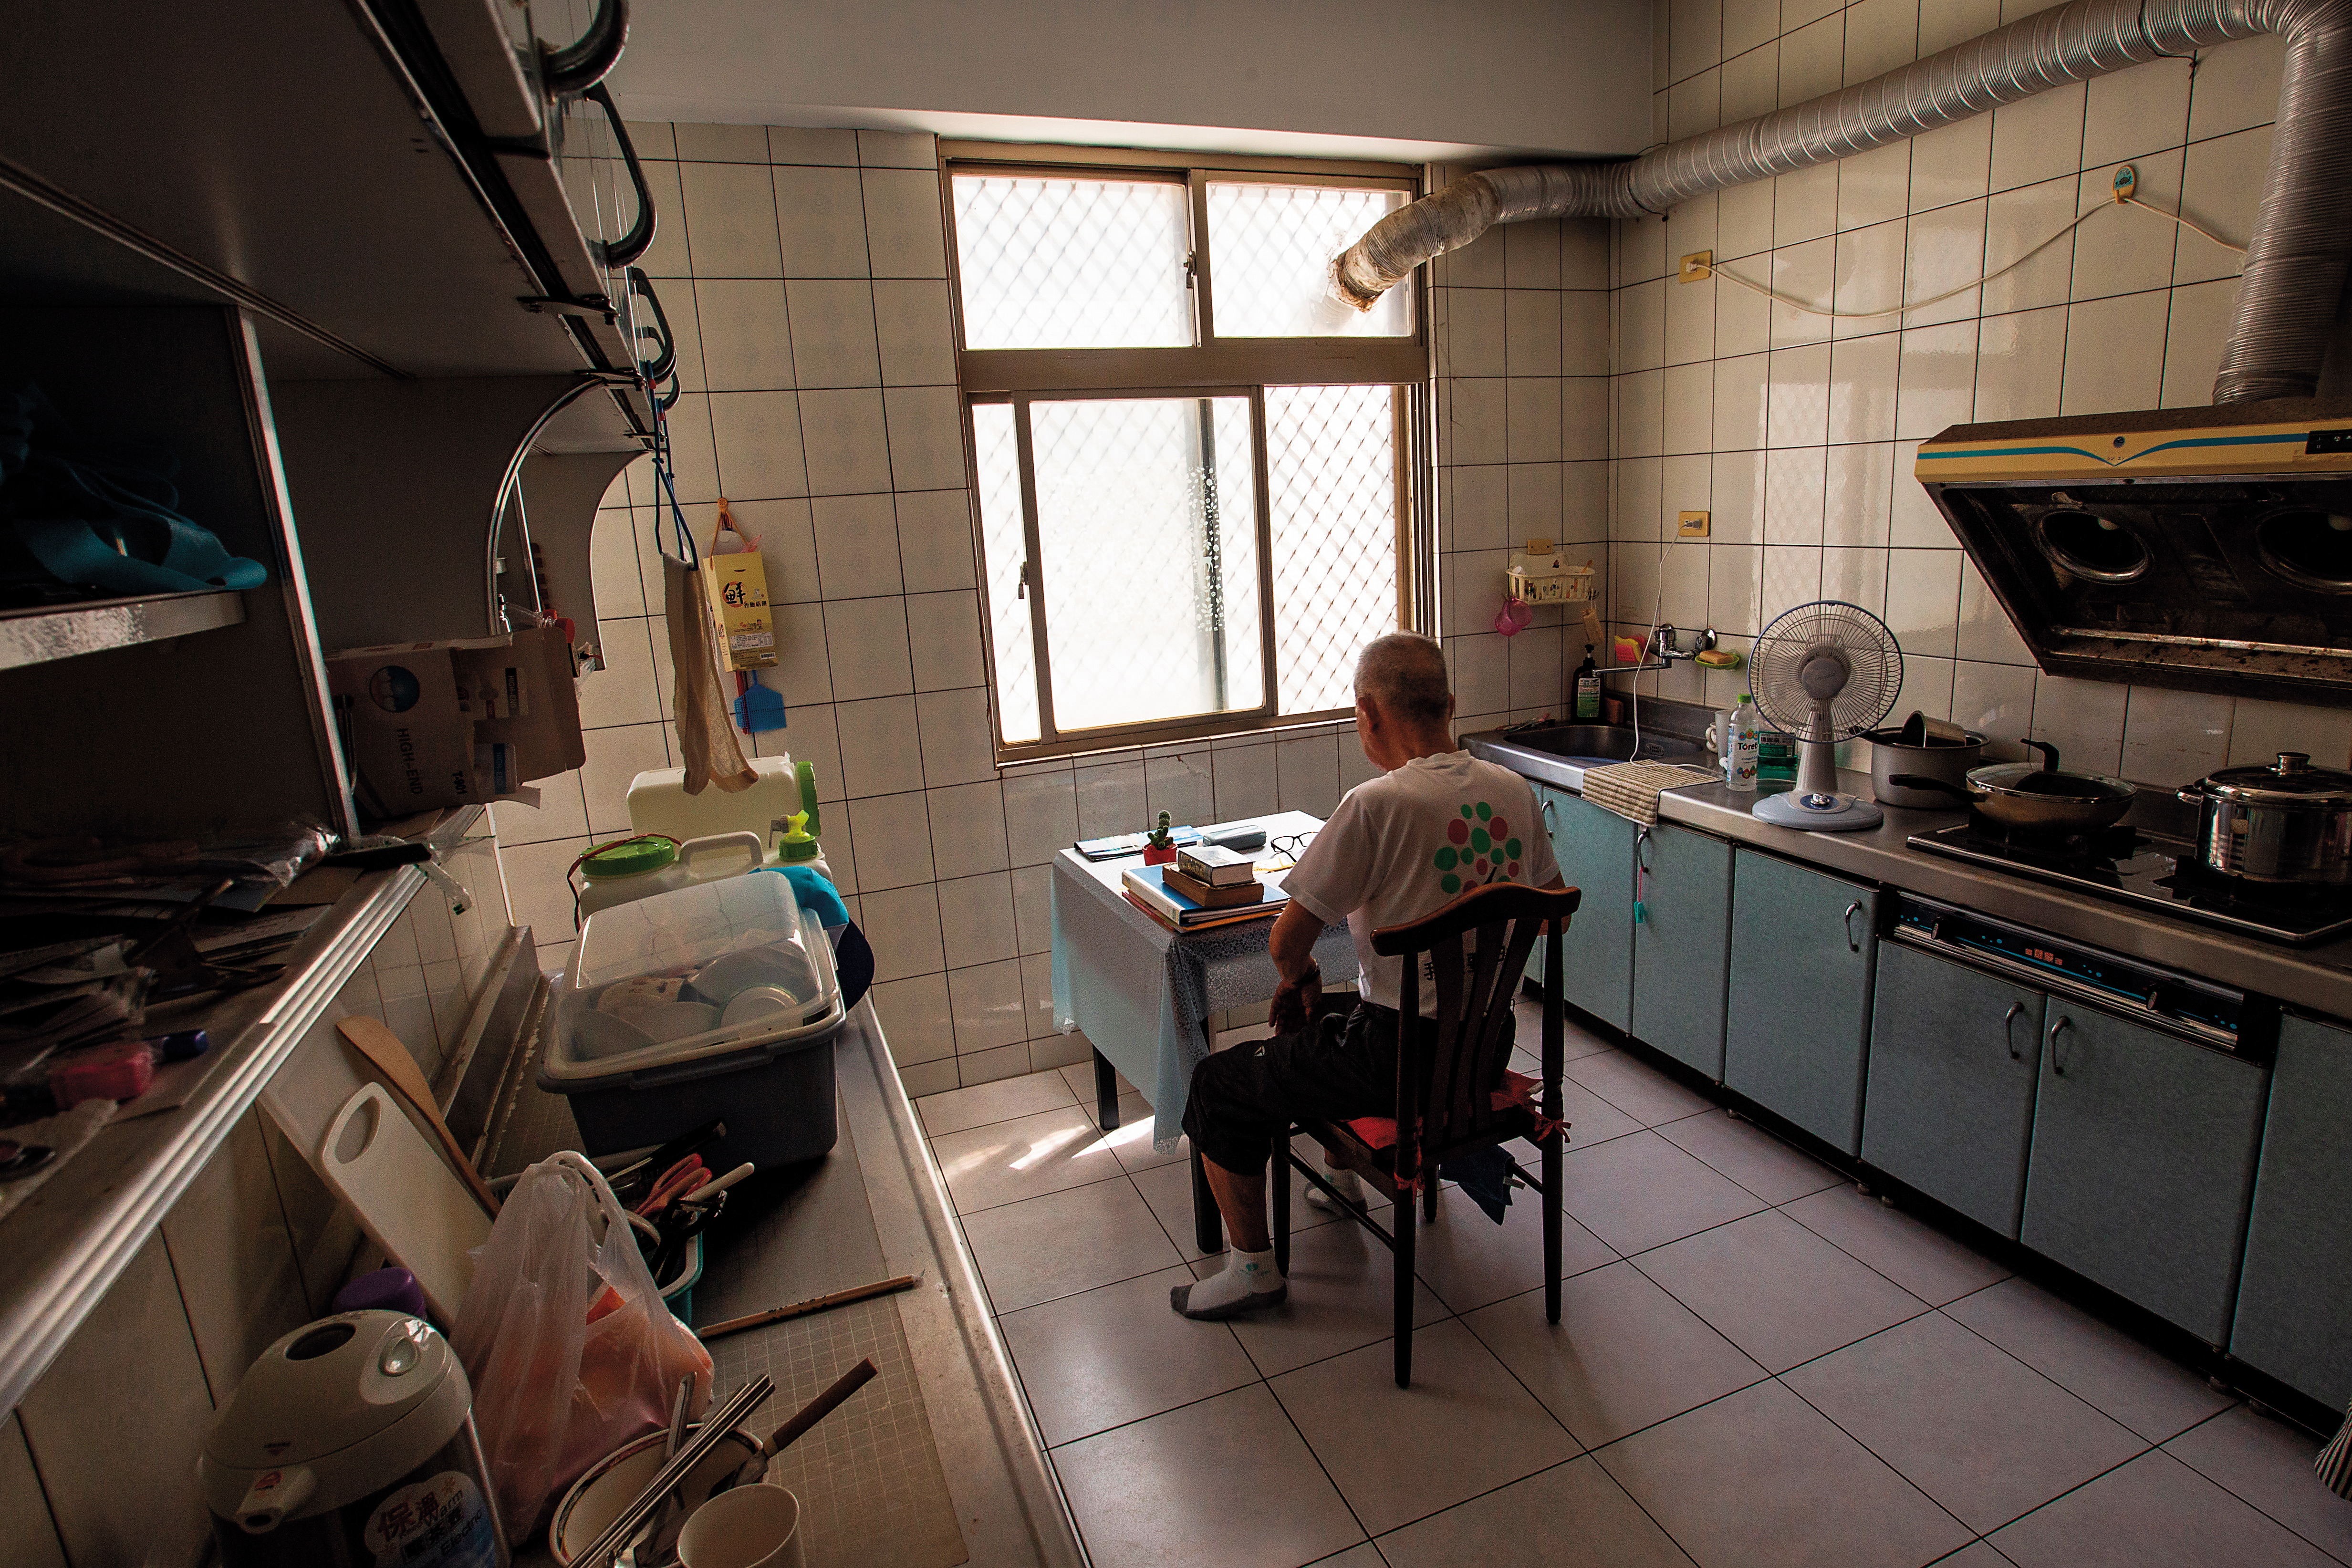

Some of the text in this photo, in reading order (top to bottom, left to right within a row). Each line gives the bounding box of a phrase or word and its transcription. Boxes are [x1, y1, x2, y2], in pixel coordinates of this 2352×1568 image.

[724, 582, 746, 604] 鮮
[1738, 742, 1758, 750] Toret
[396, 728, 423, 794] HIGH-END
[452, 770, 468, 794] T-901
[440, 1509, 483, 1556] Electric
